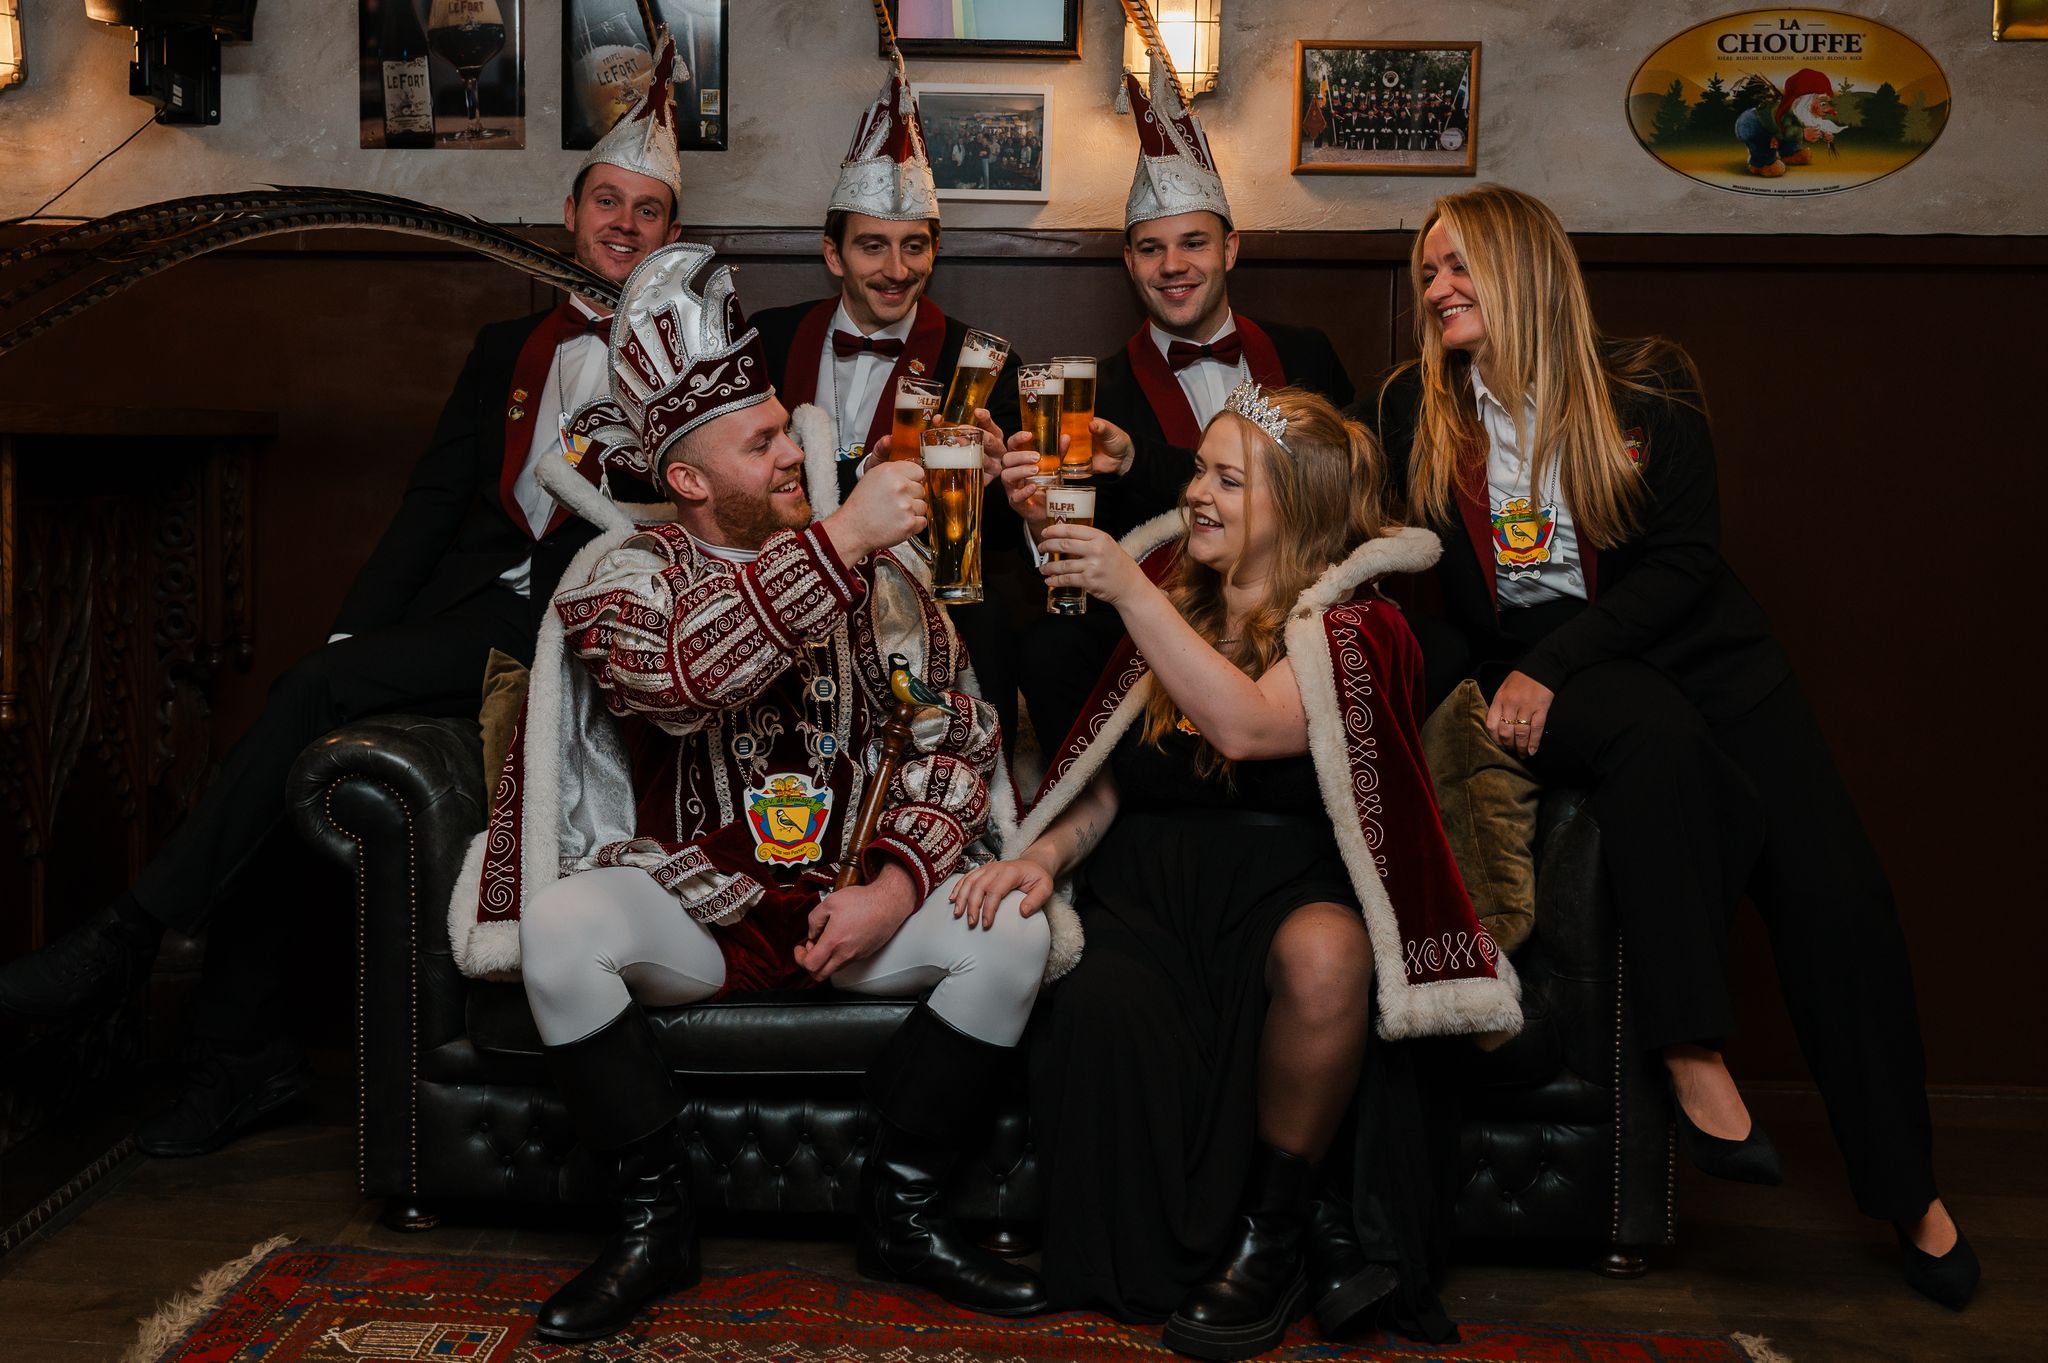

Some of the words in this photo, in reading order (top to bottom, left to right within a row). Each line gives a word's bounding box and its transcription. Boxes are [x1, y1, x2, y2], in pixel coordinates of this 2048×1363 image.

[1779, 18, 1801, 30] LA
[1717, 33, 1863, 53] CHOUFFE
[1049, 502, 1075, 511] ALFA
